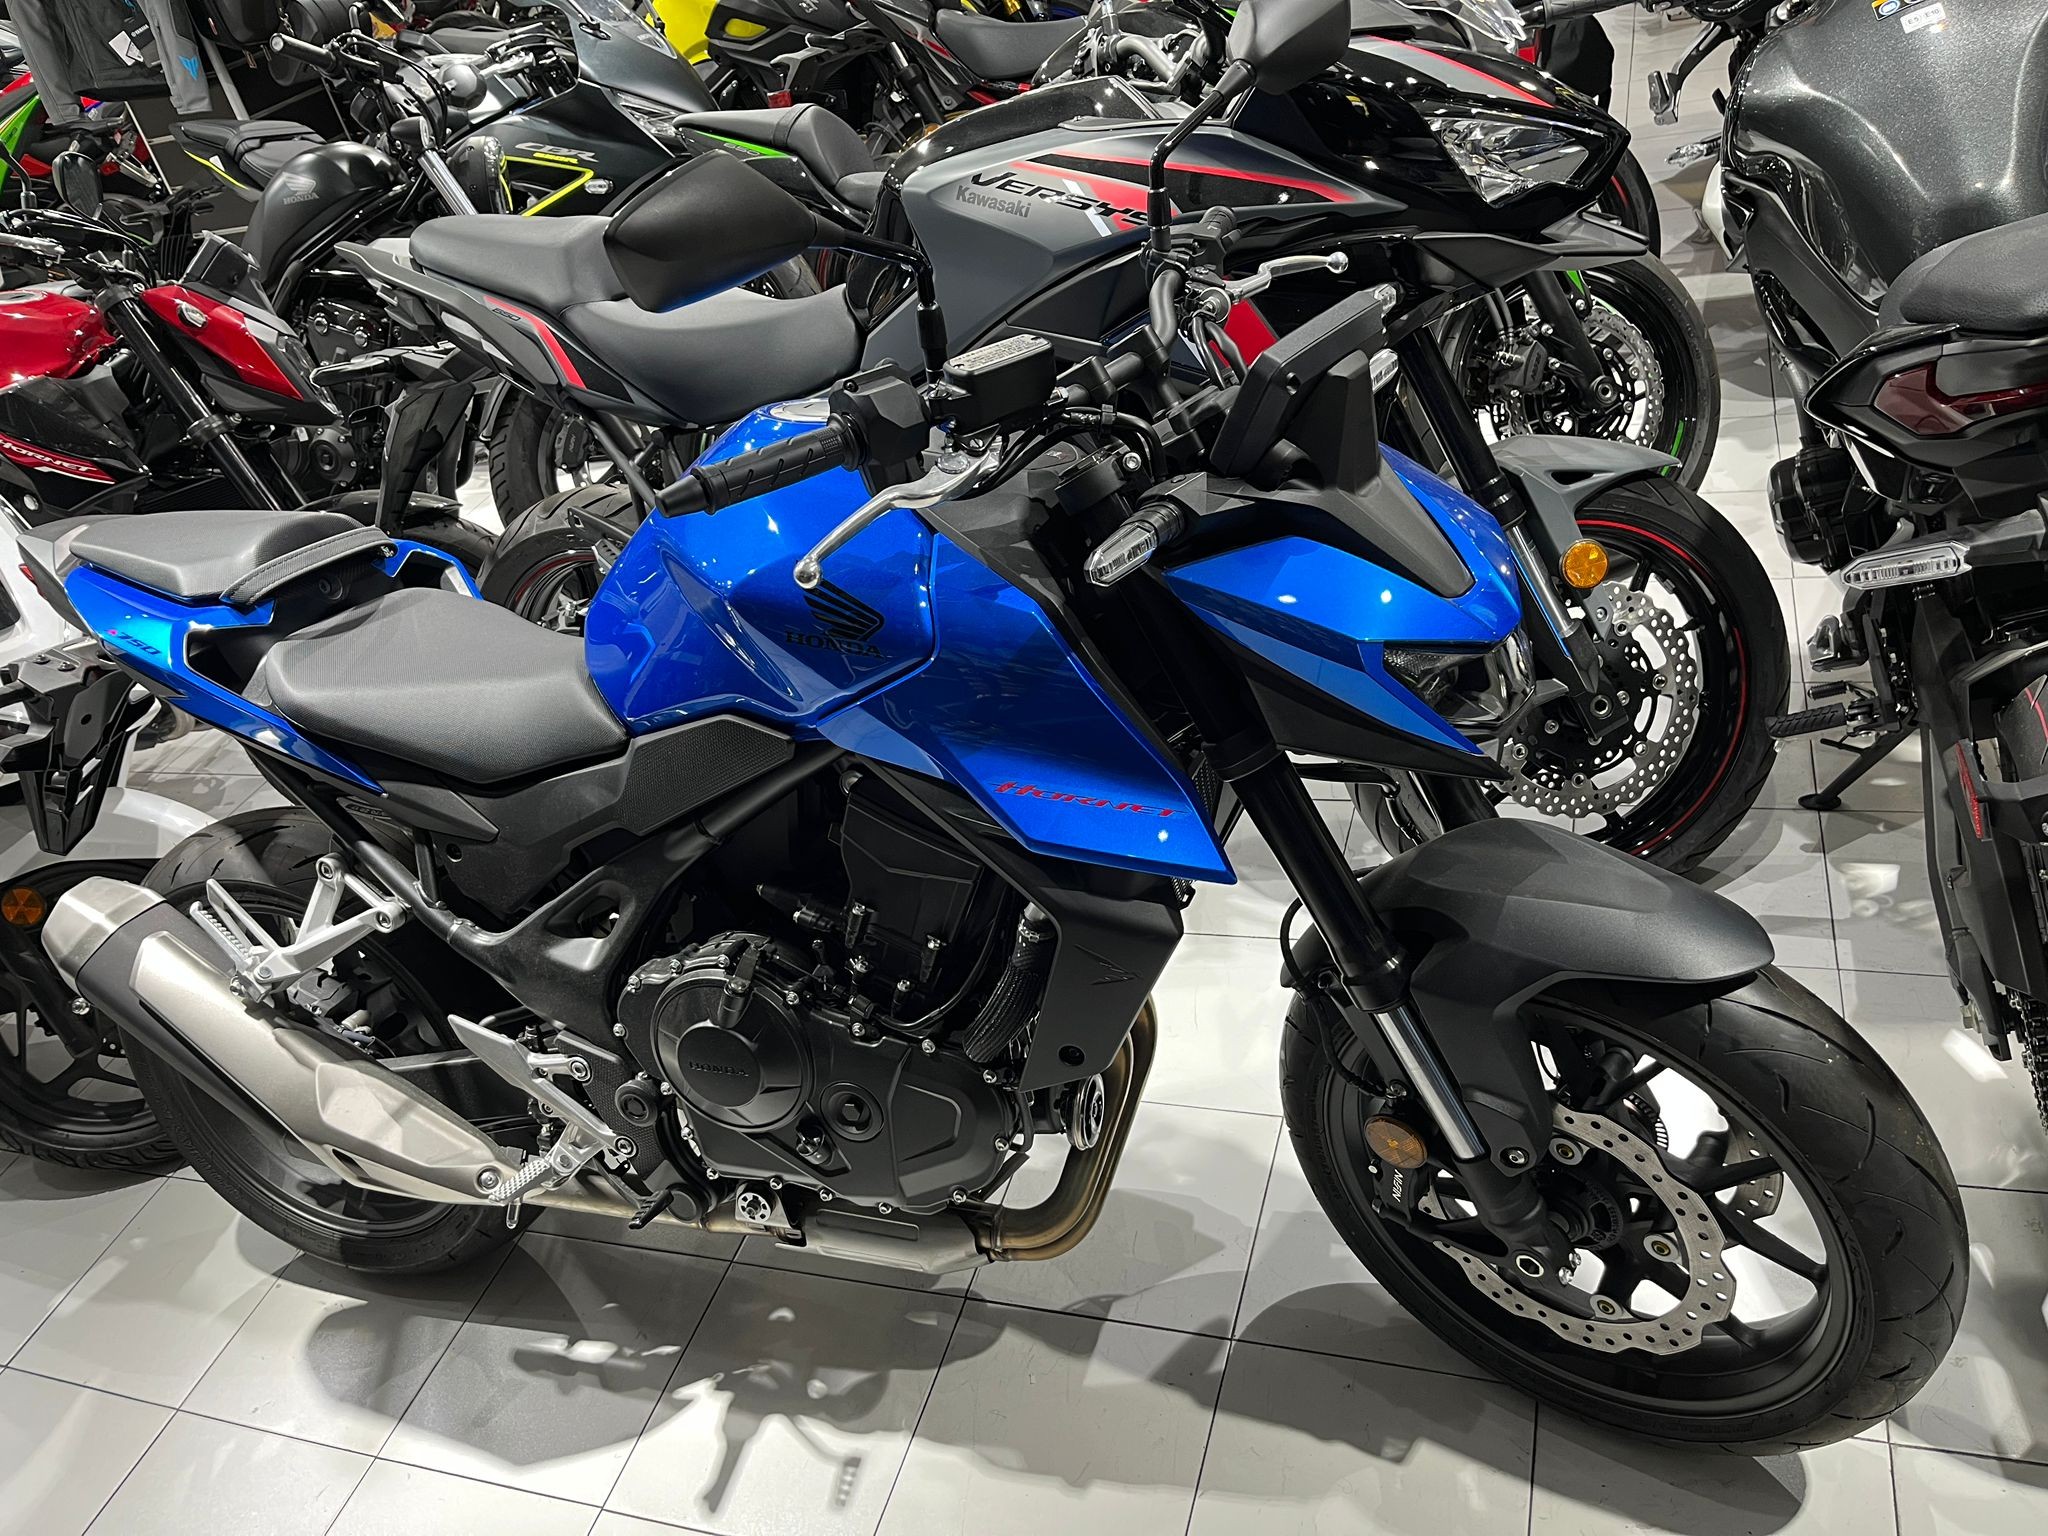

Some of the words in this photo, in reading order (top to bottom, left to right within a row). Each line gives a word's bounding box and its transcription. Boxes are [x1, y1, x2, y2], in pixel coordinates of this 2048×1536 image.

[514, 142, 599, 162] CBR
[283, 191, 320, 205] HONDA
[955, 184, 1031, 219] Kawasaki
[117, 632, 162, 655] 750
[785, 629, 886, 661] HONDA
[990, 781, 1191, 817] HORNET
[688, 1061, 750, 1077] HONDA
